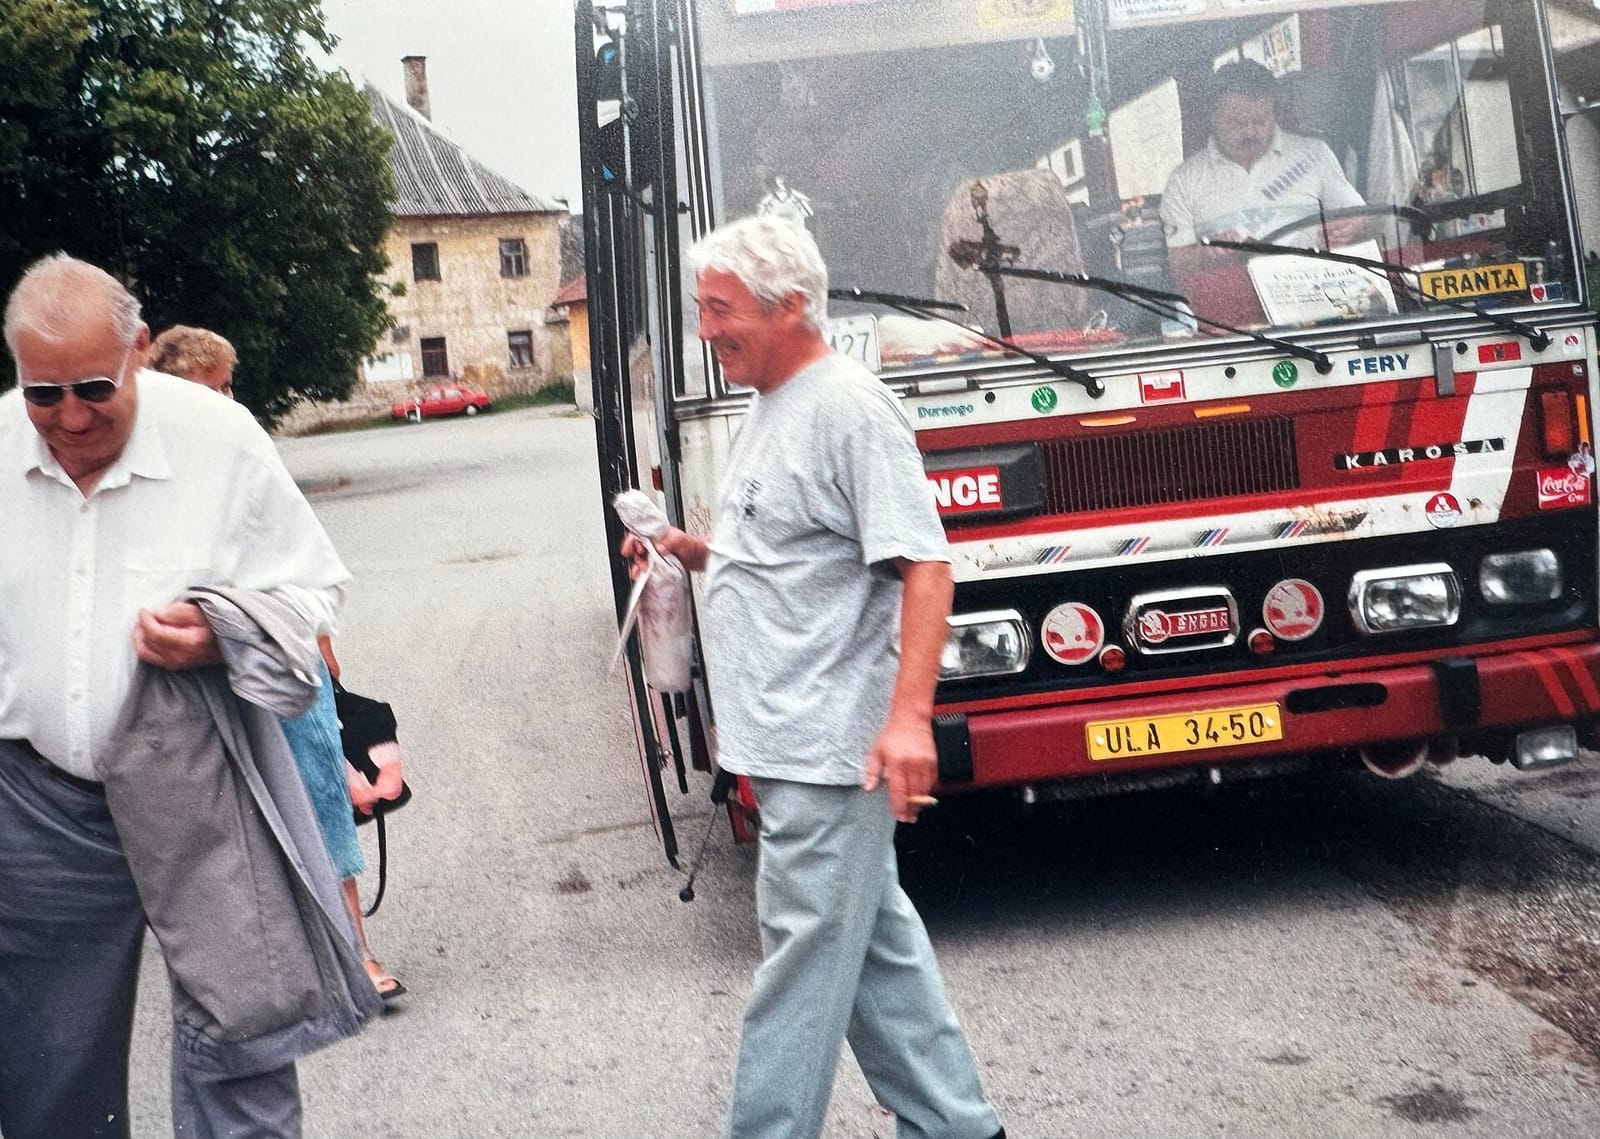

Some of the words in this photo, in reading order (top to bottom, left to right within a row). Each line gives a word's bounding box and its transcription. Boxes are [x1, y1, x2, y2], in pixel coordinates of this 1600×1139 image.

[1431, 269, 1519, 296] FRANTA
[1348, 353, 1409, 376] FERY
[1345, 438, 1495, 470] KAROSA
[1105, 723, 1160, 753] ULA
